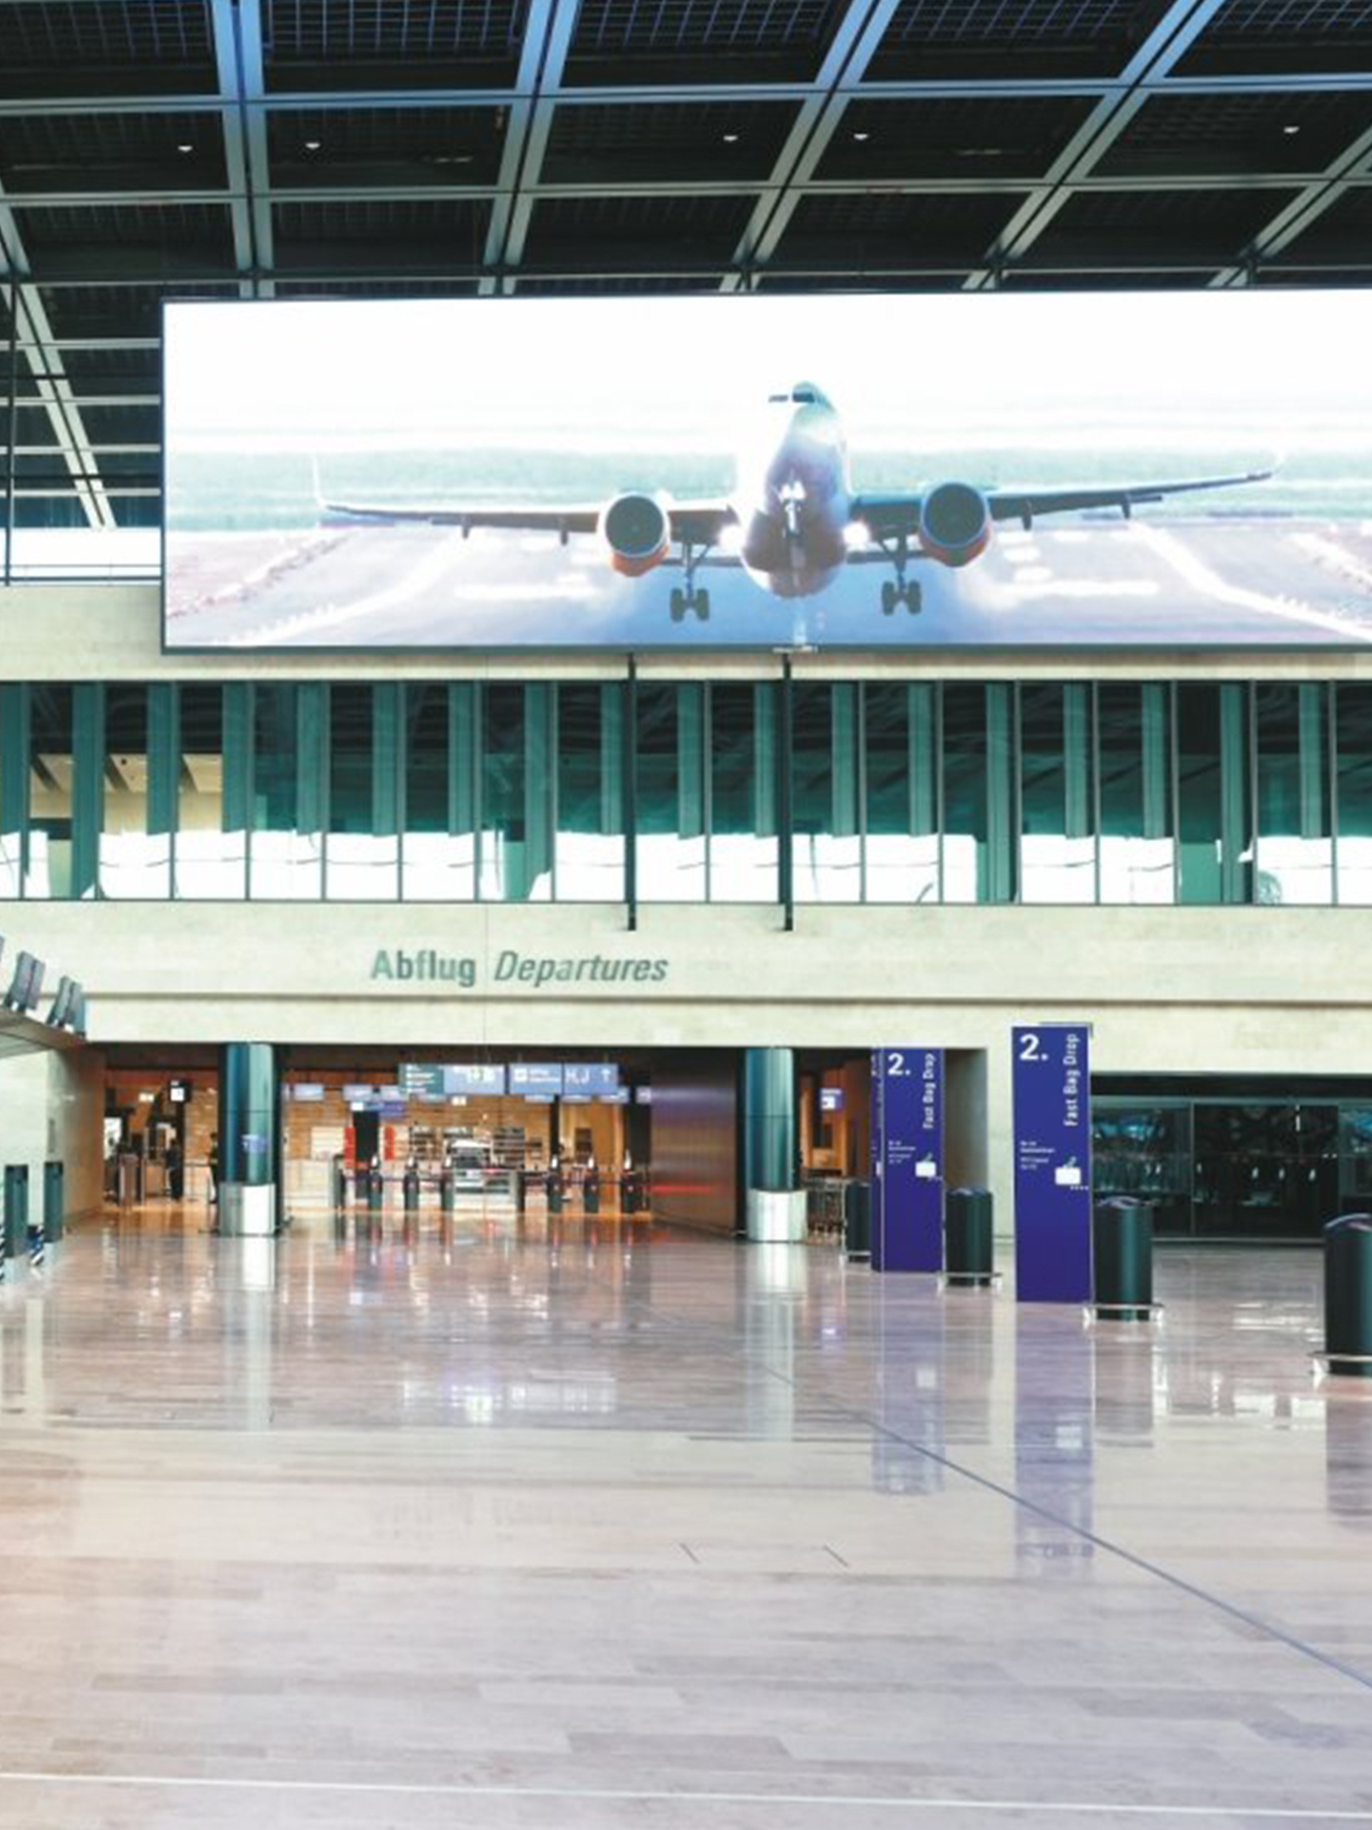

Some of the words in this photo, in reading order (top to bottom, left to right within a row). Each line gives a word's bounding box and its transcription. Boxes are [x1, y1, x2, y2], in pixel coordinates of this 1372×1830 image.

[370, 949, 477, 988] Abflug
[493, 949, 669, 988] Departures
[1019, 1033, 1049, 1061] 2.
[1062, 1033, 1081, 1066] Drop
[888, 1052, 911, 1076] 2.
[1062, 1069, 1081, 1095] Bag
[1062, 1098, 1079, 1127] Fast
